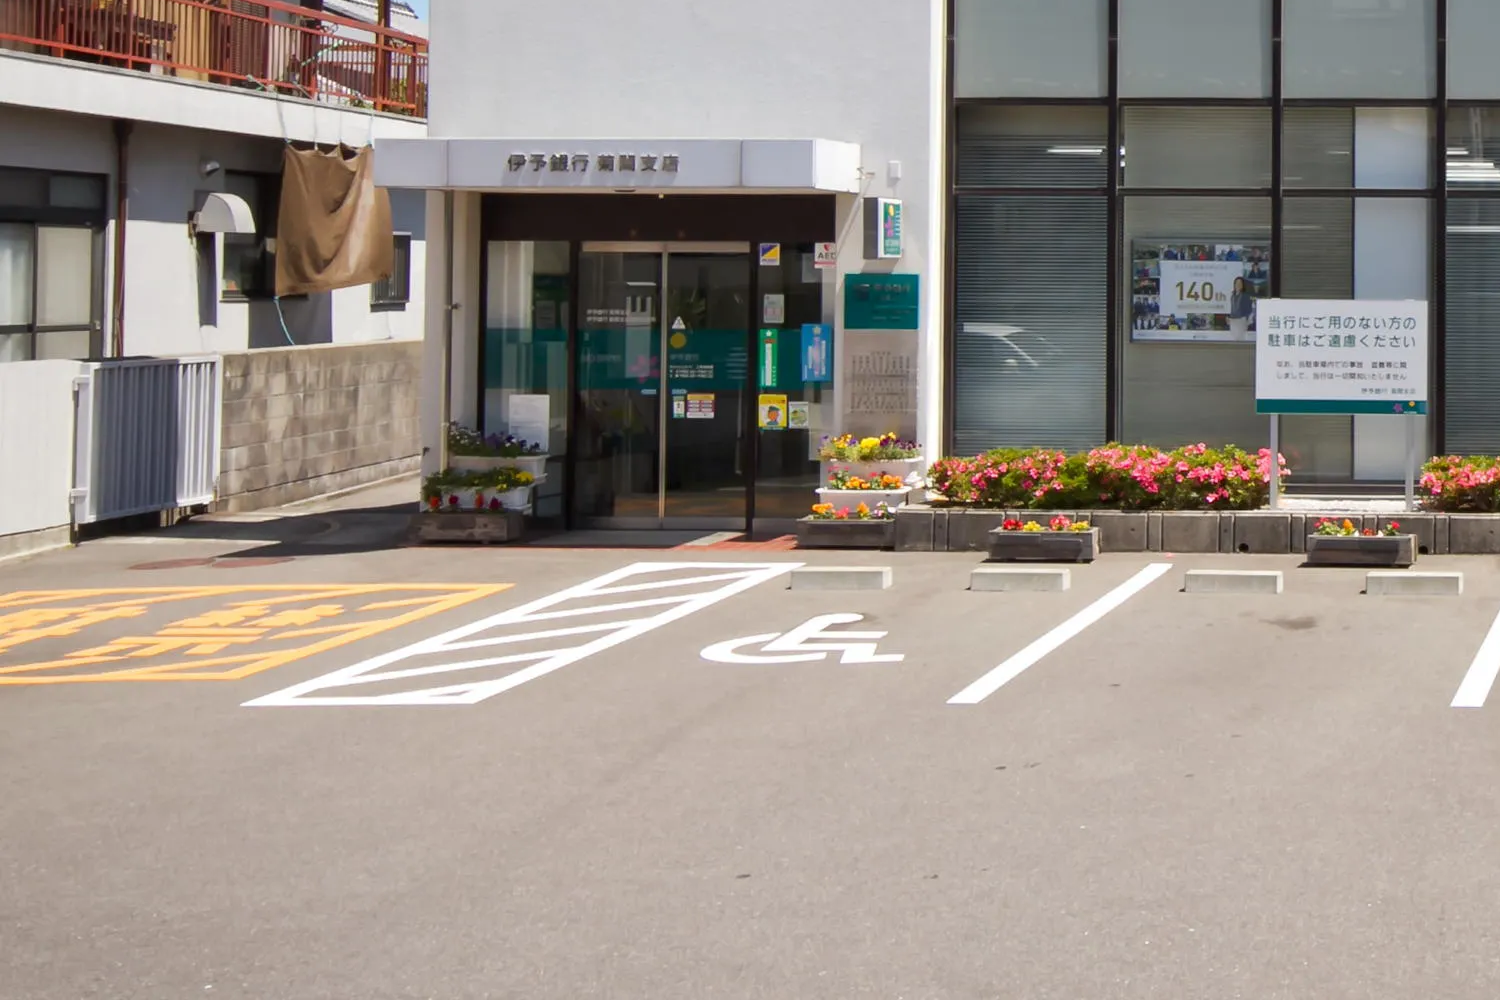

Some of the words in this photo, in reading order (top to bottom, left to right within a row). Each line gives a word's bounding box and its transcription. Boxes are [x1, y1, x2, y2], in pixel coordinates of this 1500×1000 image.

[508, 153, 589, 172] 伊予銀行
[1267, 315, 1417, 330] 当行にご用のない方の
[1267, 334, 1417, 348] 駐車はご遠慮ください
